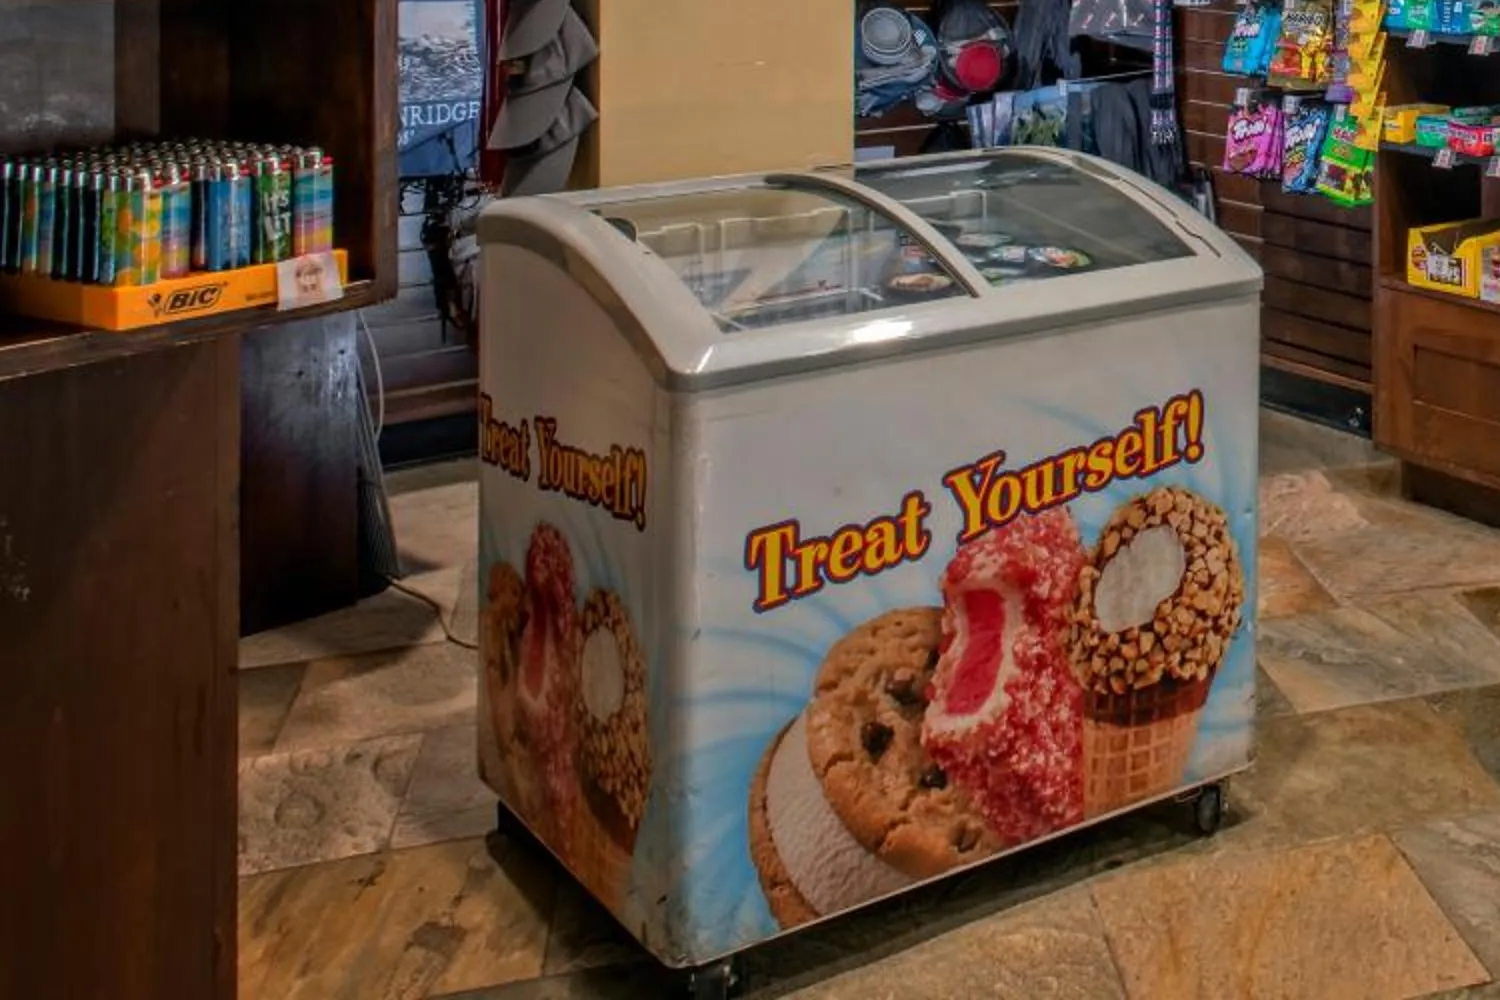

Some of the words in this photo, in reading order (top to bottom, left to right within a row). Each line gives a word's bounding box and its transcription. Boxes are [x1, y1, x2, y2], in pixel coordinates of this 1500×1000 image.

[168, 287, 218, 311] BIC
[479, 391, 532, 482] Treat
[533, 414, 648, 533] Yourself!
[745, 494, 932, 612] Treat
[944, 390, 1206, 544] Yourself!
